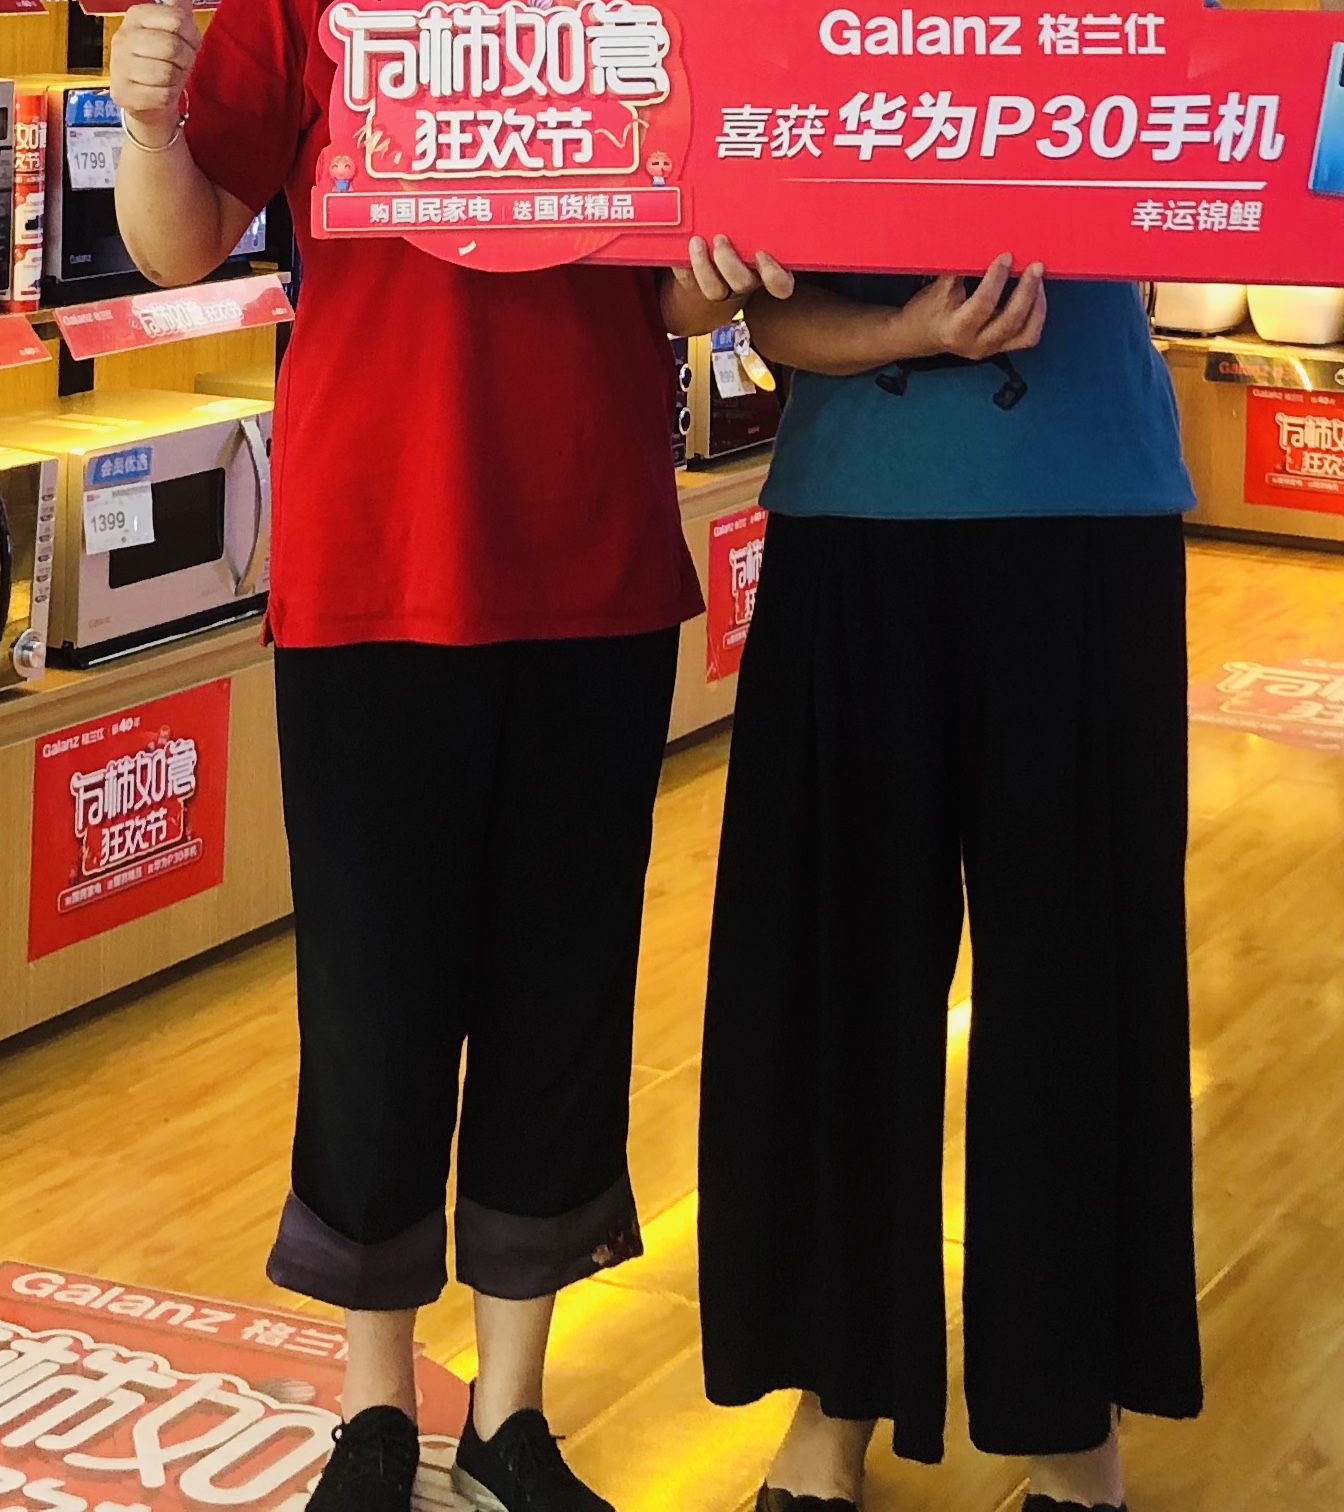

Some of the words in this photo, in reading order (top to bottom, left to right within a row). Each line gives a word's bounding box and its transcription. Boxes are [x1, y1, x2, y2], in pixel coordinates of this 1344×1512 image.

[819, 8, 1022, 57] Galanz
[1037, 11, 1166, 56] 格兰仕
[411, 106, 593, 171] 狂欢节
[714, 89, 1286, 163] 喜获华为P30手机
[73, 152, 106, 169] 1799
[369, 196, 494, 224] 购国民家电
[512, 193, 635, 222] 送国货精品
[1130, 200, 1263, 233] 幸运锦鲤
[99, 451, 148, 480] 会员优选
[90, 510, 127, 535] 1399
[42, 736, 80, 758] Galanz
[99, 806, 168, 867] 狂欢节
[9, 1270, 236, 1333] Galanz
